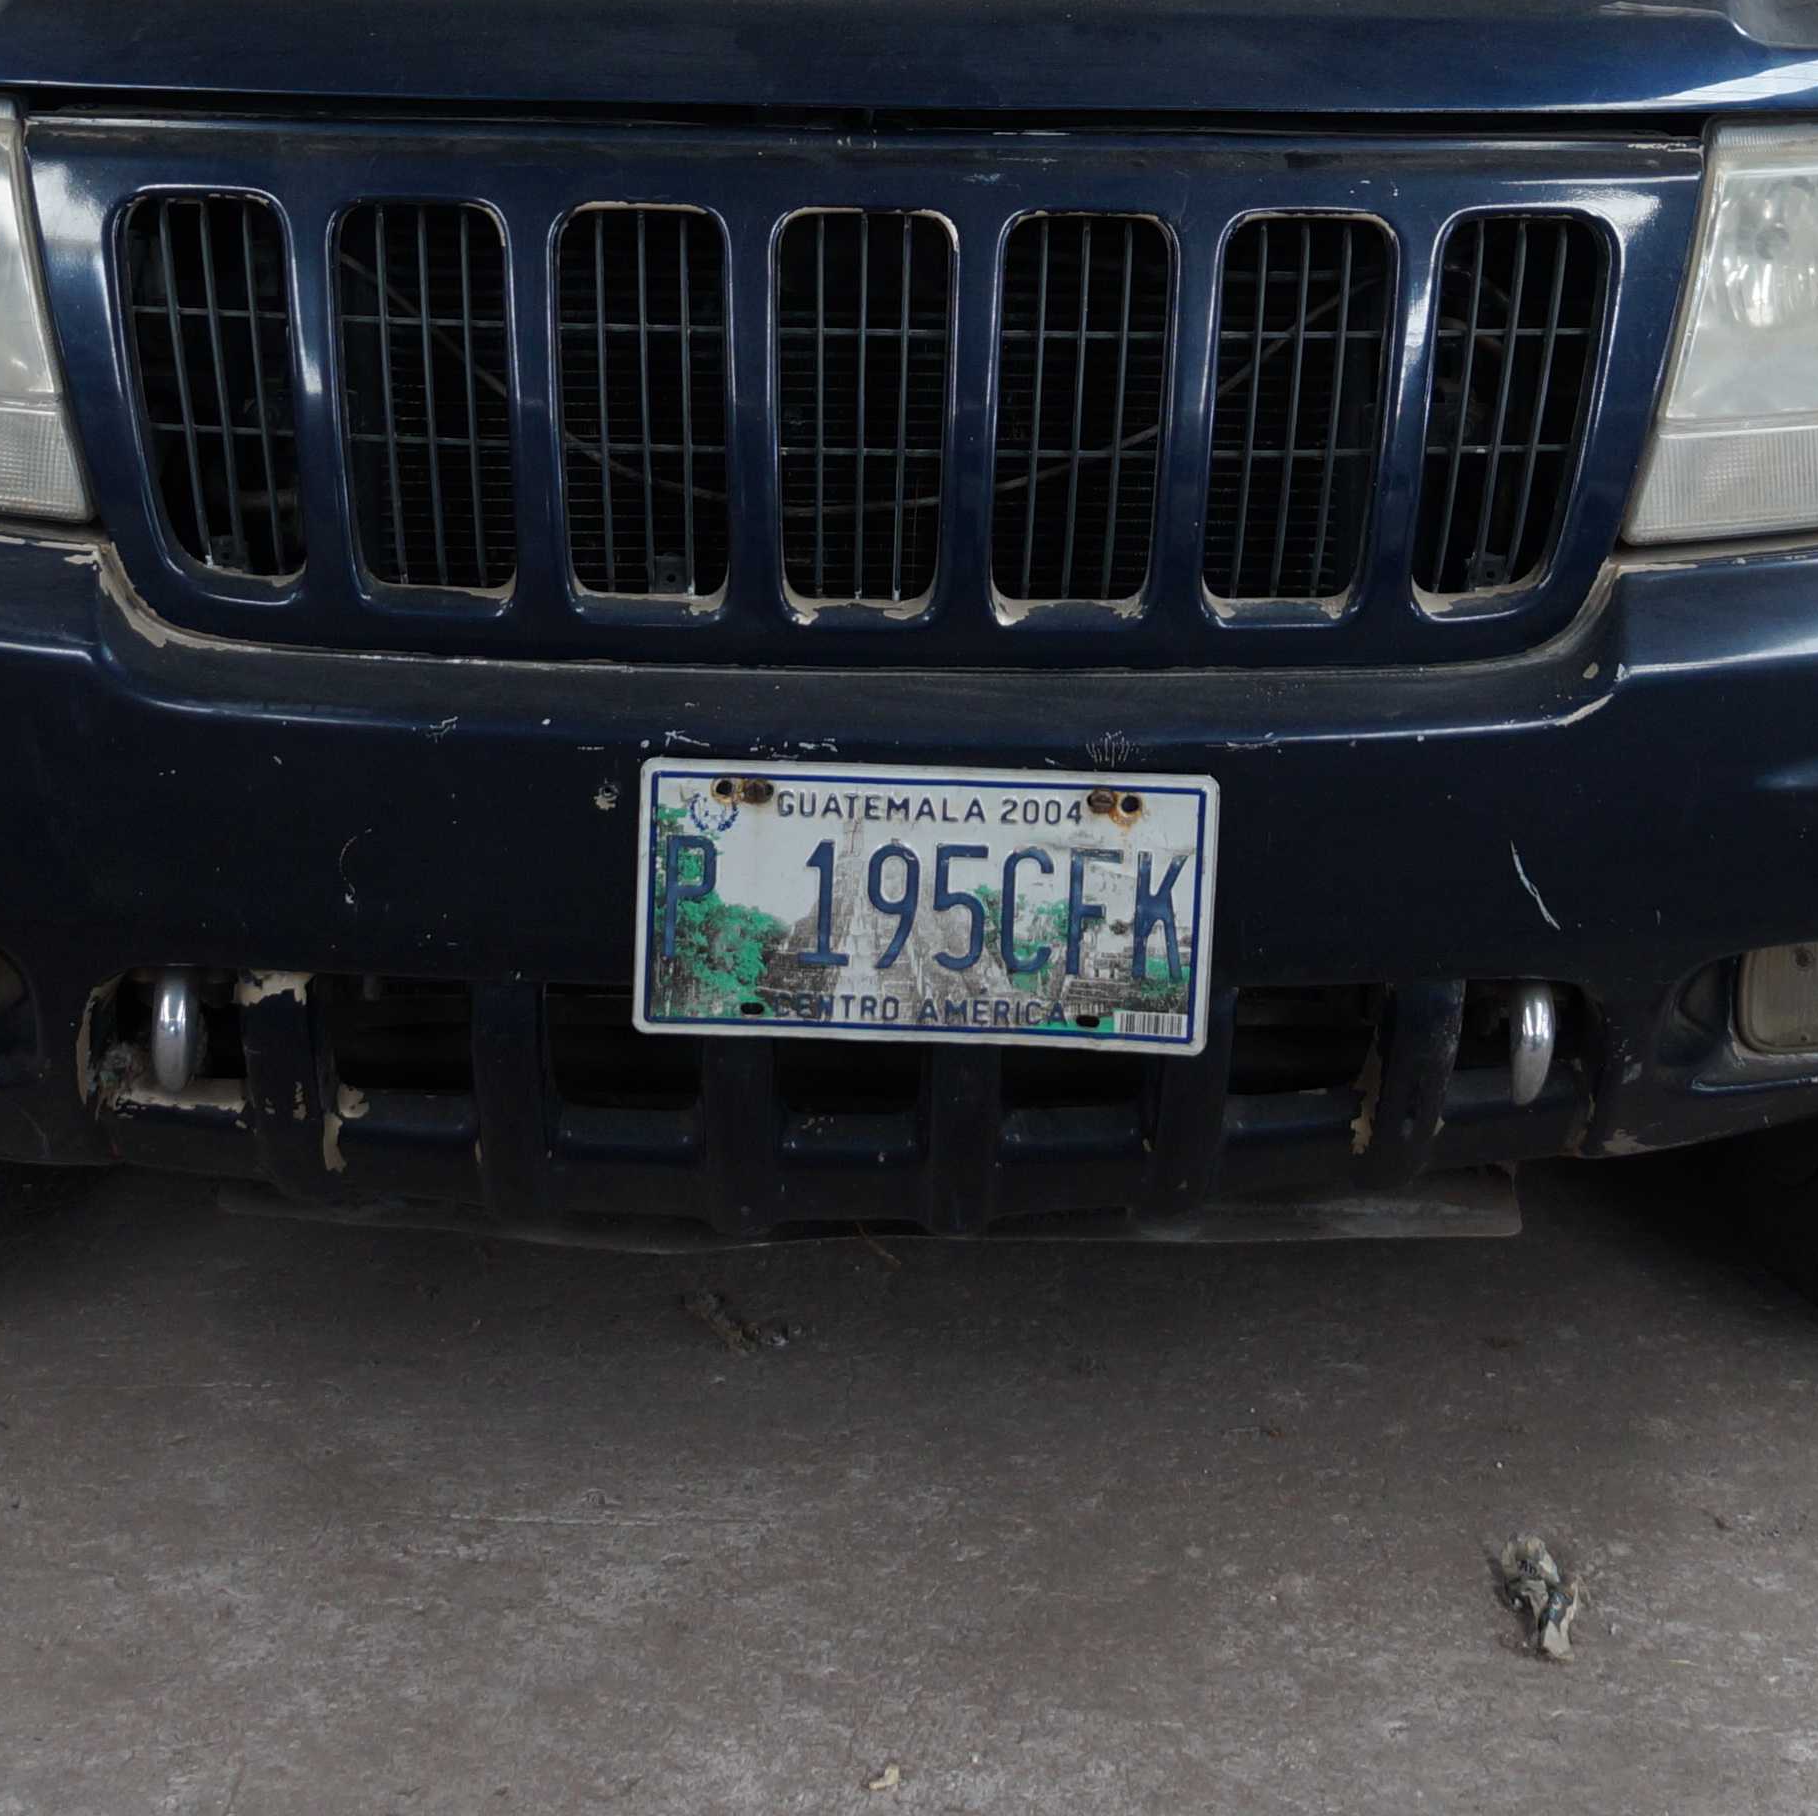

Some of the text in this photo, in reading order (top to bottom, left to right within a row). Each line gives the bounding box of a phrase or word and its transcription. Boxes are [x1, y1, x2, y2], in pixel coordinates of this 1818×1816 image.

[777, 791, 1084, 825] GUATEMALA 2004
[663, 835, 1189, 980] P 195CFK
[775, 992, 900, 1022] CENTRO
